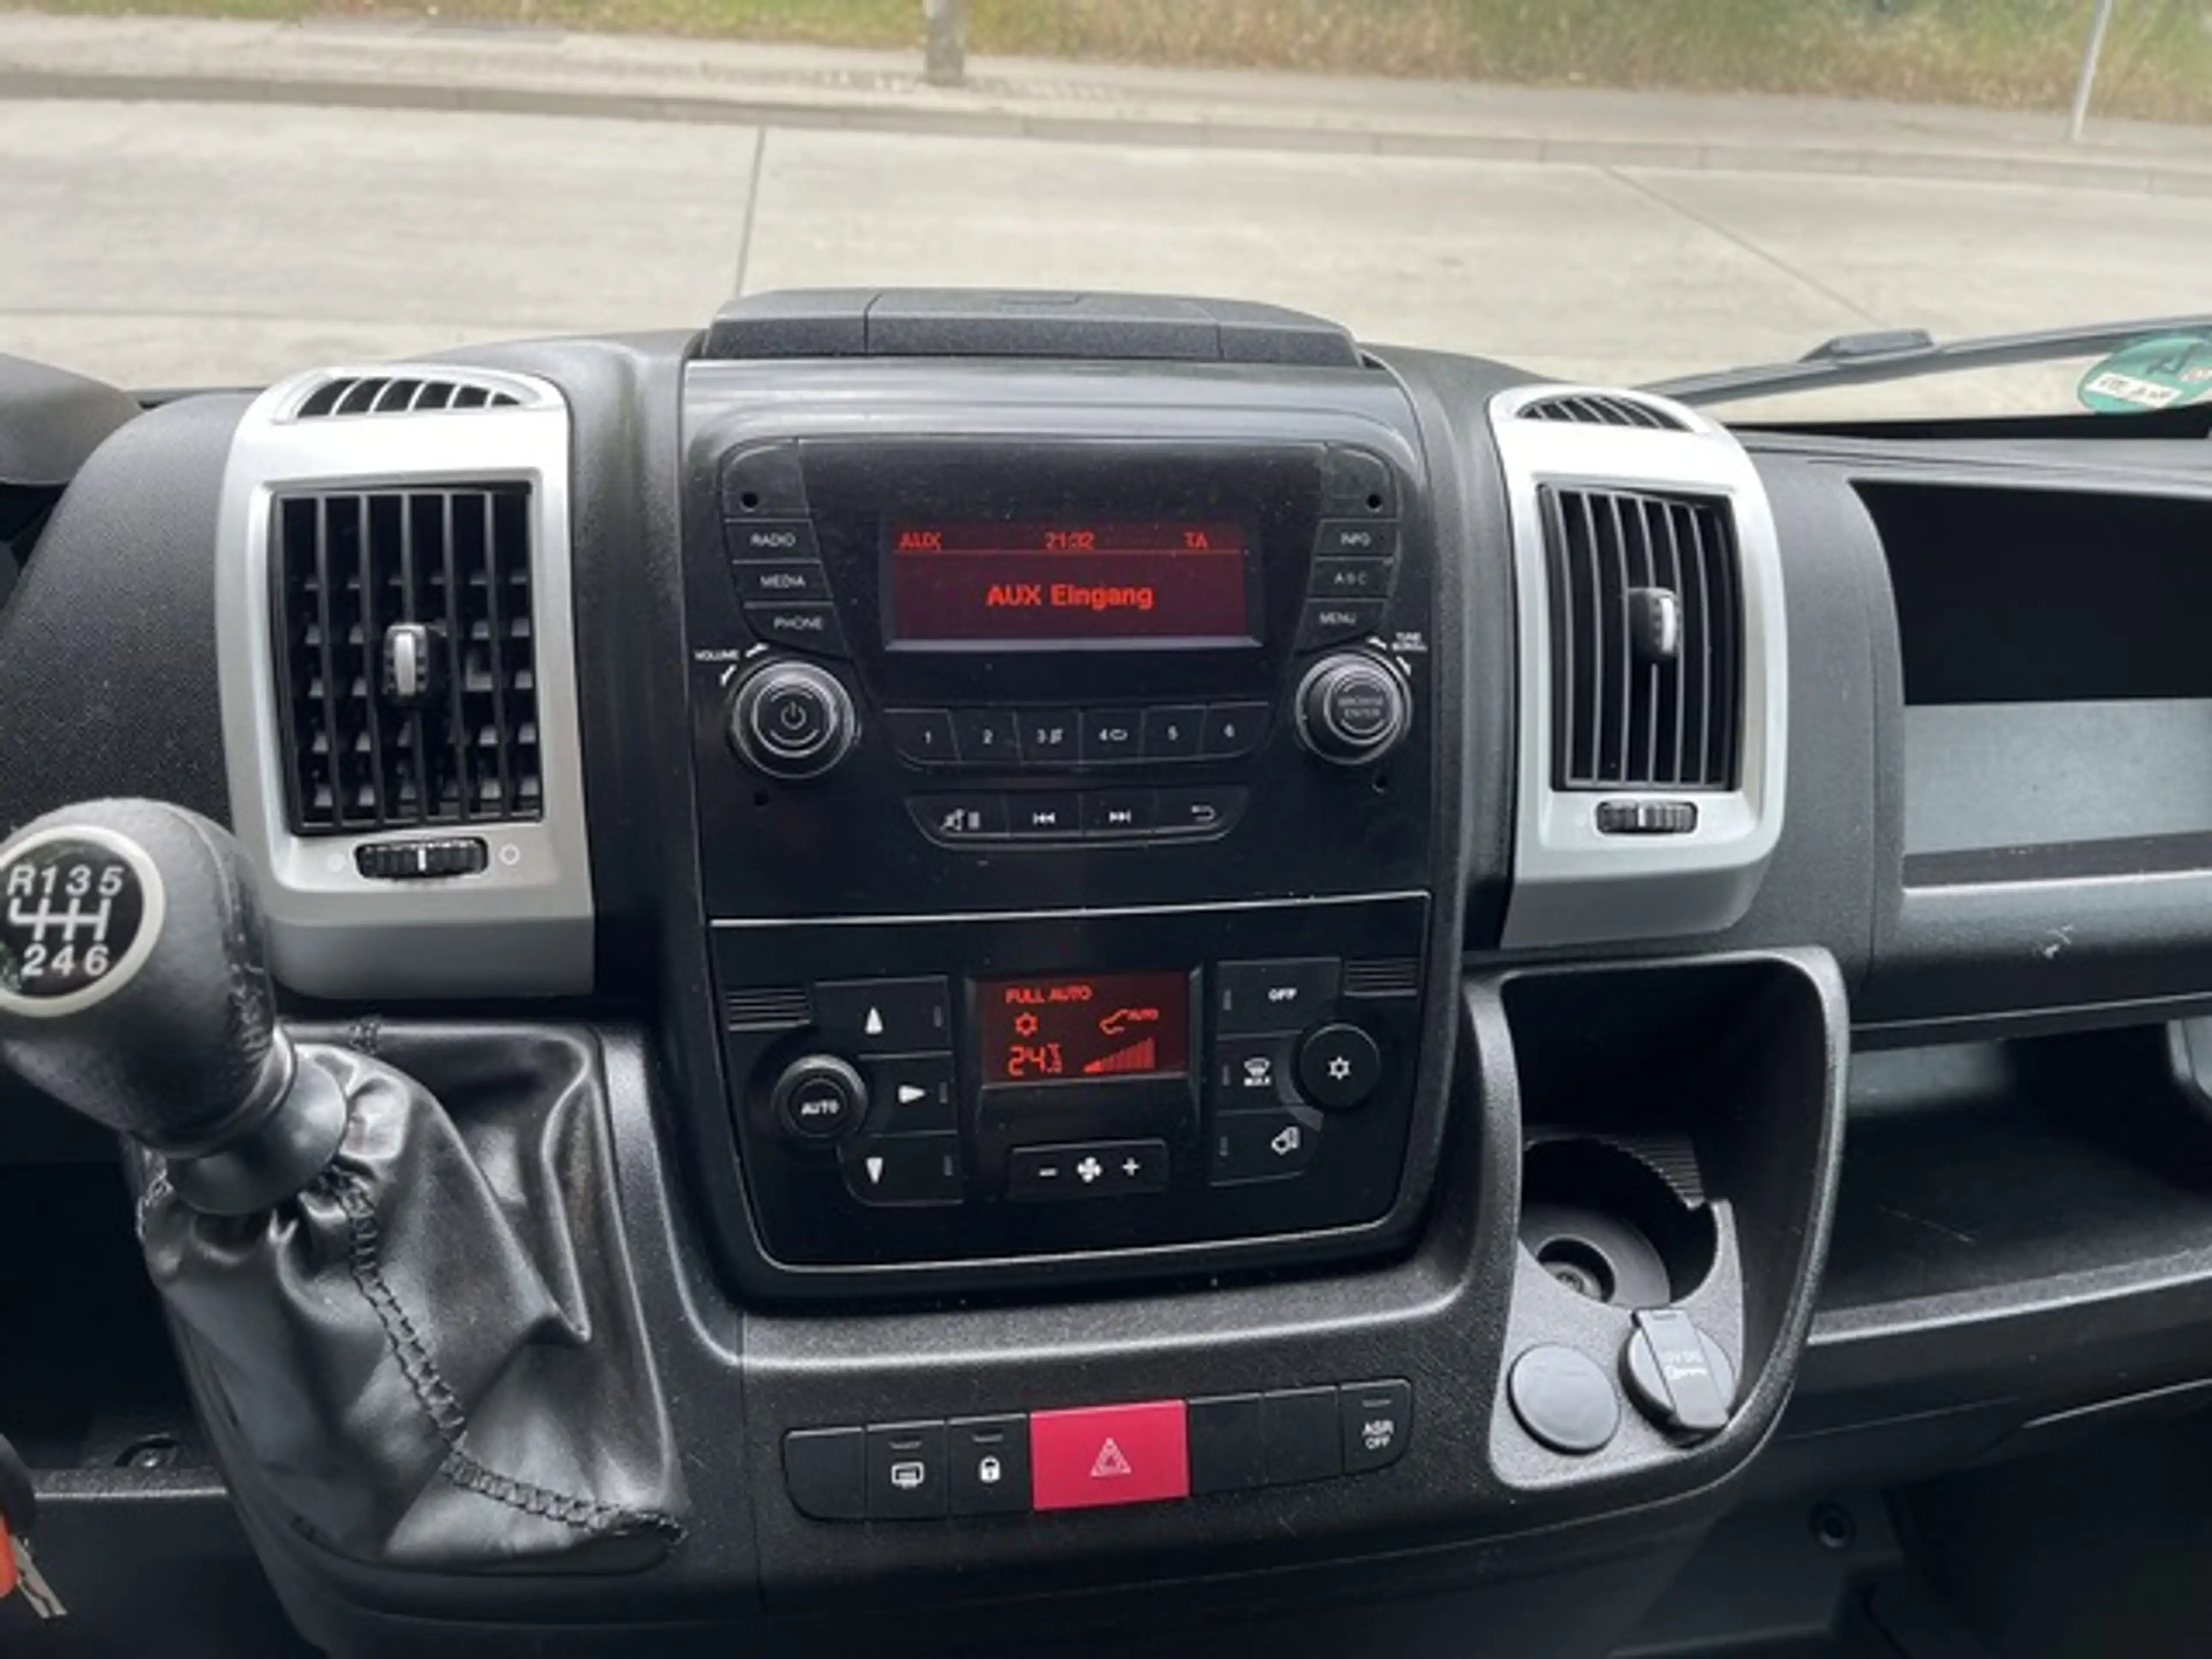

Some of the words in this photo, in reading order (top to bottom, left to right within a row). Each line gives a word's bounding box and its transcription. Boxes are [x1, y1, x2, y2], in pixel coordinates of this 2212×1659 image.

[750, 532, 796, 547] RADIO
[899, 532, 942, 551] AUX
[1184, 531, 1209, 548] TA
[1340, 532, 1371, 547] INFO
[760, 574, 805, 589] MEDIA
[986, 584, 1041, 606] AUX
[1051, 584, 1153, 611] Eingang
[774, 615, 824, 630] PHONE
[1320, 611, 1357, 624] MENU
[694, 649, 740, 661] VOLUME
[925, 730, 931, 744] 1
[983, 729, 993, 745] 2
[1006, 988, 1045, 1003] FULL
[1048, 984, 1093, 1001] AUTO
[1268, 988, 1297, 1003] OFF
[801, 1099, 840, 1116] AUTO
[1362, 1420, 1394, 1437] ASR
[1365, 1435, 1391, 1450] OFF
